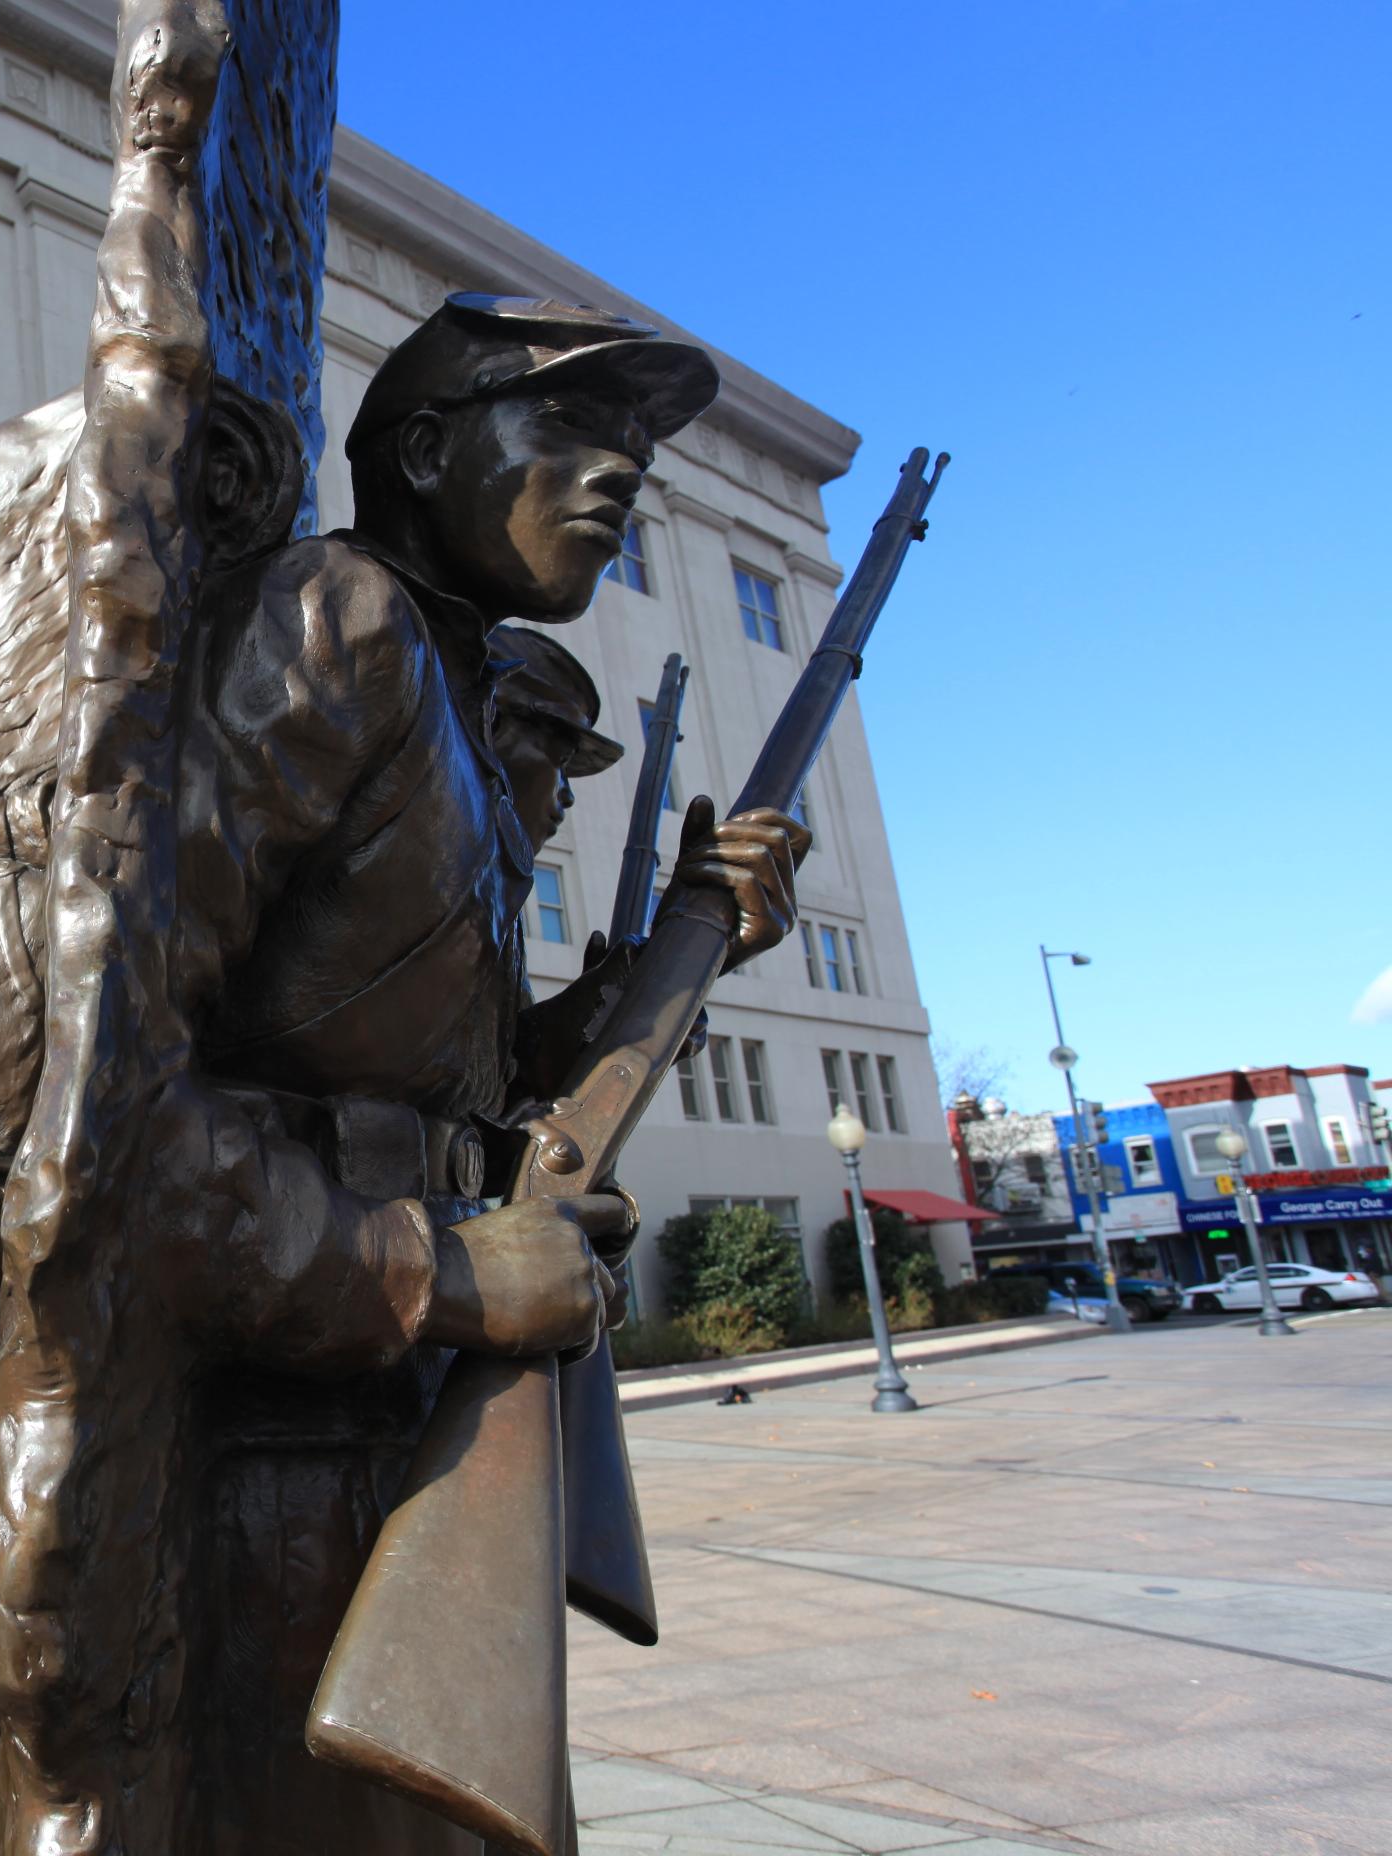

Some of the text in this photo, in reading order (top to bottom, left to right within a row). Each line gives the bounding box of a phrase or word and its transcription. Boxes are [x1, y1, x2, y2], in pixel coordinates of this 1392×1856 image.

[1280, 1198, 1384, 1213] George Carry Out
